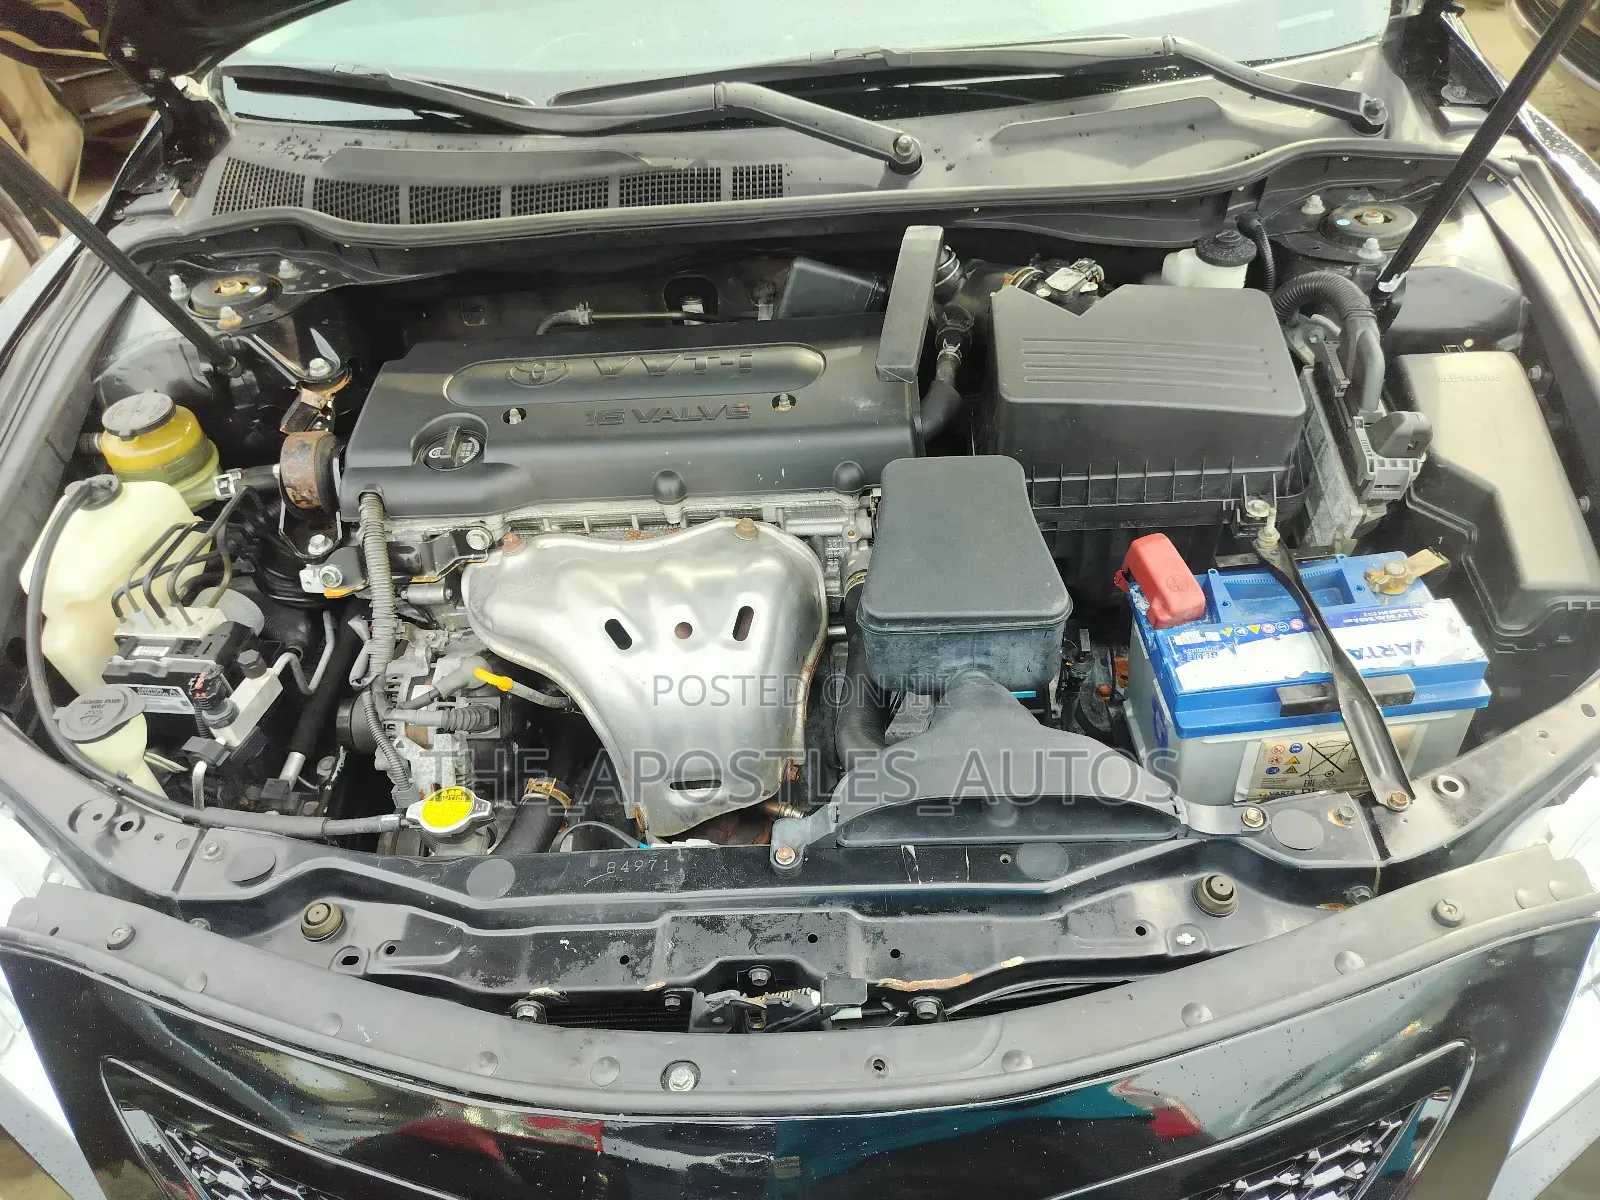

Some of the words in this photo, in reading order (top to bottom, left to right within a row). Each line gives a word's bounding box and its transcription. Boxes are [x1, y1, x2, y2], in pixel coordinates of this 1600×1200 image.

[584, 408, 626, 427] 16
[631, 401, 750, 424] VALVE
[1268, 789, 1297, 797] VARTA
[606, 859, 669, 874] 84971
